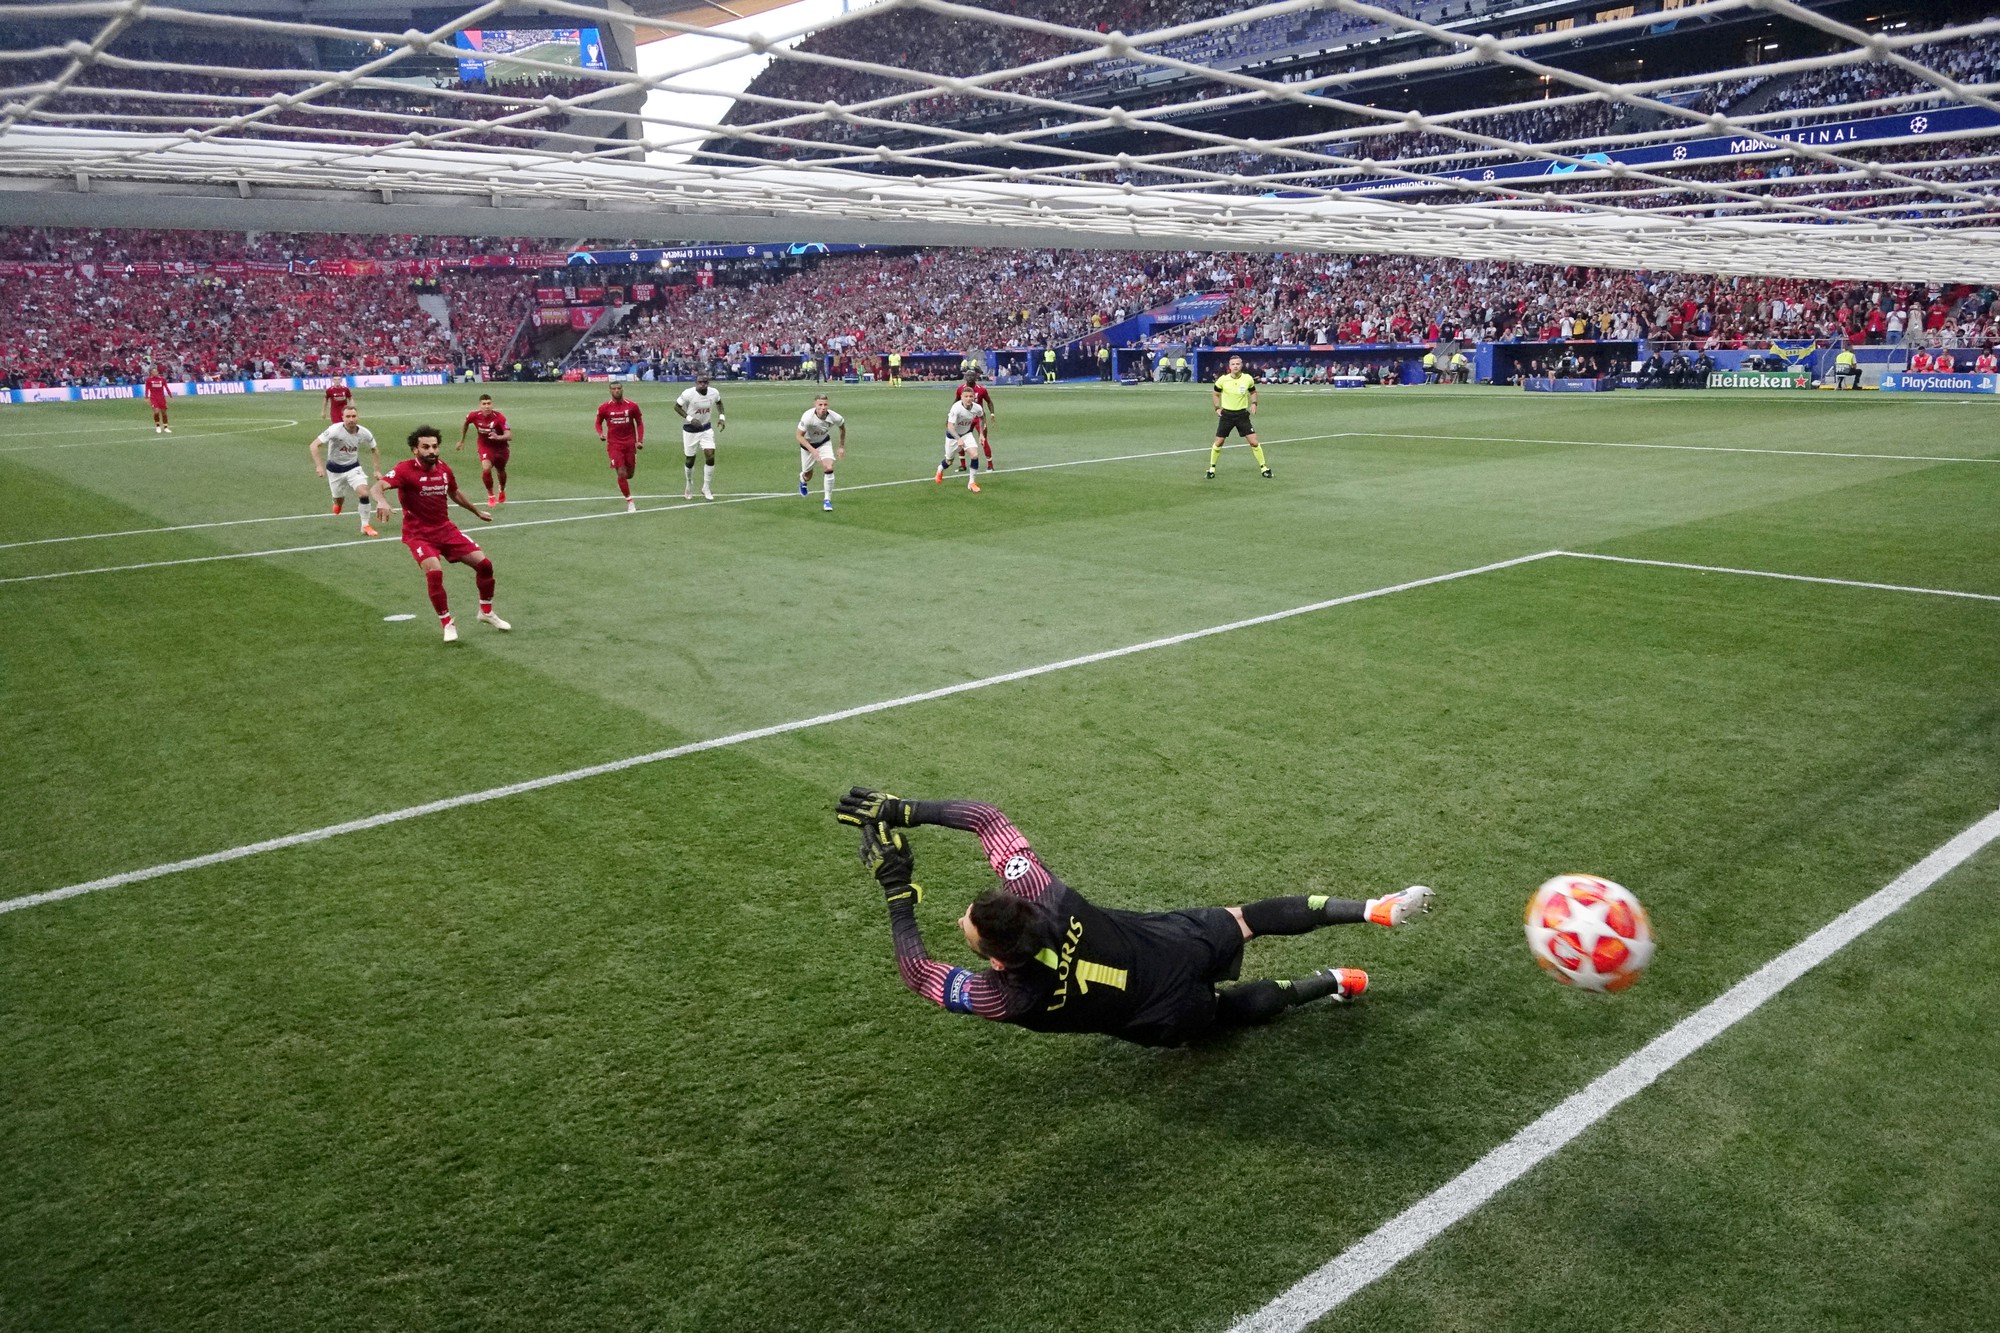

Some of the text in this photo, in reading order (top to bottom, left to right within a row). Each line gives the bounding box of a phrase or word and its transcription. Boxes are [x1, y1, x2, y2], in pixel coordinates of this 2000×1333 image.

[1206, 104, 1229, 112] LEAGUE
[1799, 127, 1857, 144] FINAL
[695, 248, 724, 257] FINAL
[401, 374, 443, 386] GAZPROM
[1711, 374, 1791, 388] Heineken
[1902, 376, 1971, 391] PlayStation
[81, 386, 134, 400] GAZPROM
[196, 382, 245, 395] GAZPROM
[1046, 915, 1083, 1012] LLORIS
[1075, 958, 1128, 995] 1
